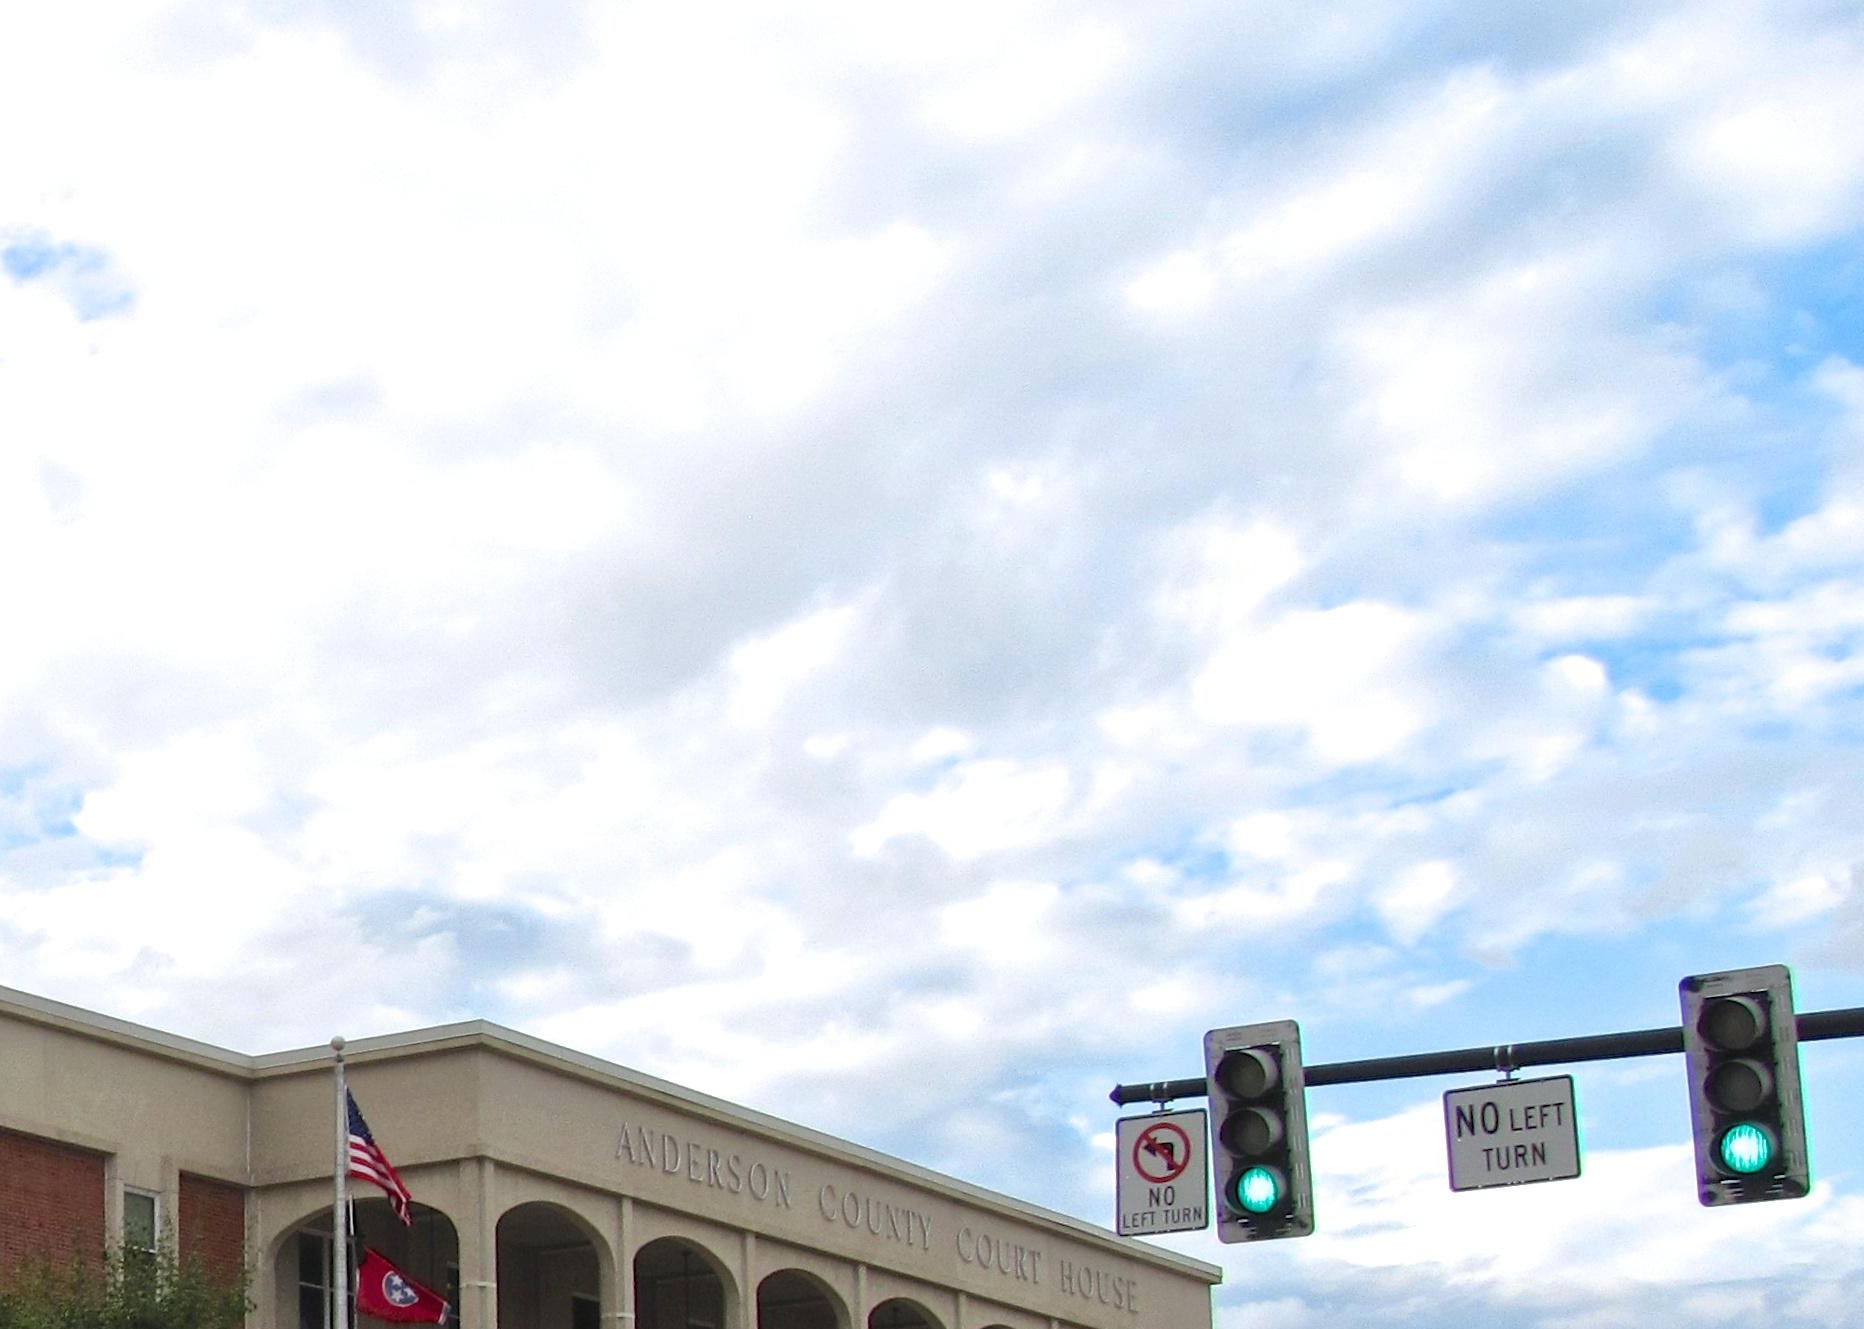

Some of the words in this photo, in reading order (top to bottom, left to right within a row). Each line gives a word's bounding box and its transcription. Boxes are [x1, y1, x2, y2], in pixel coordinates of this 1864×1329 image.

[1456, 1101, 1499, 1138] NO
[1509, 1102, 1564, 1131] LEFT
[1482, 1142, 1546, 1172] TURN
[1149, 1185, 1175, 1208] NO
[615, 1121, 791, 1208] ANDERSON
[819, 1184, 932, 1251] COUNTY
[956, 1227, 1041, 1284] COURT
[1060, 1260, 1138, 1313] HOUSE
[1123, 1211, 1155, 1228] LEFT
[1164, 1206, 1202, 1224] TURN
